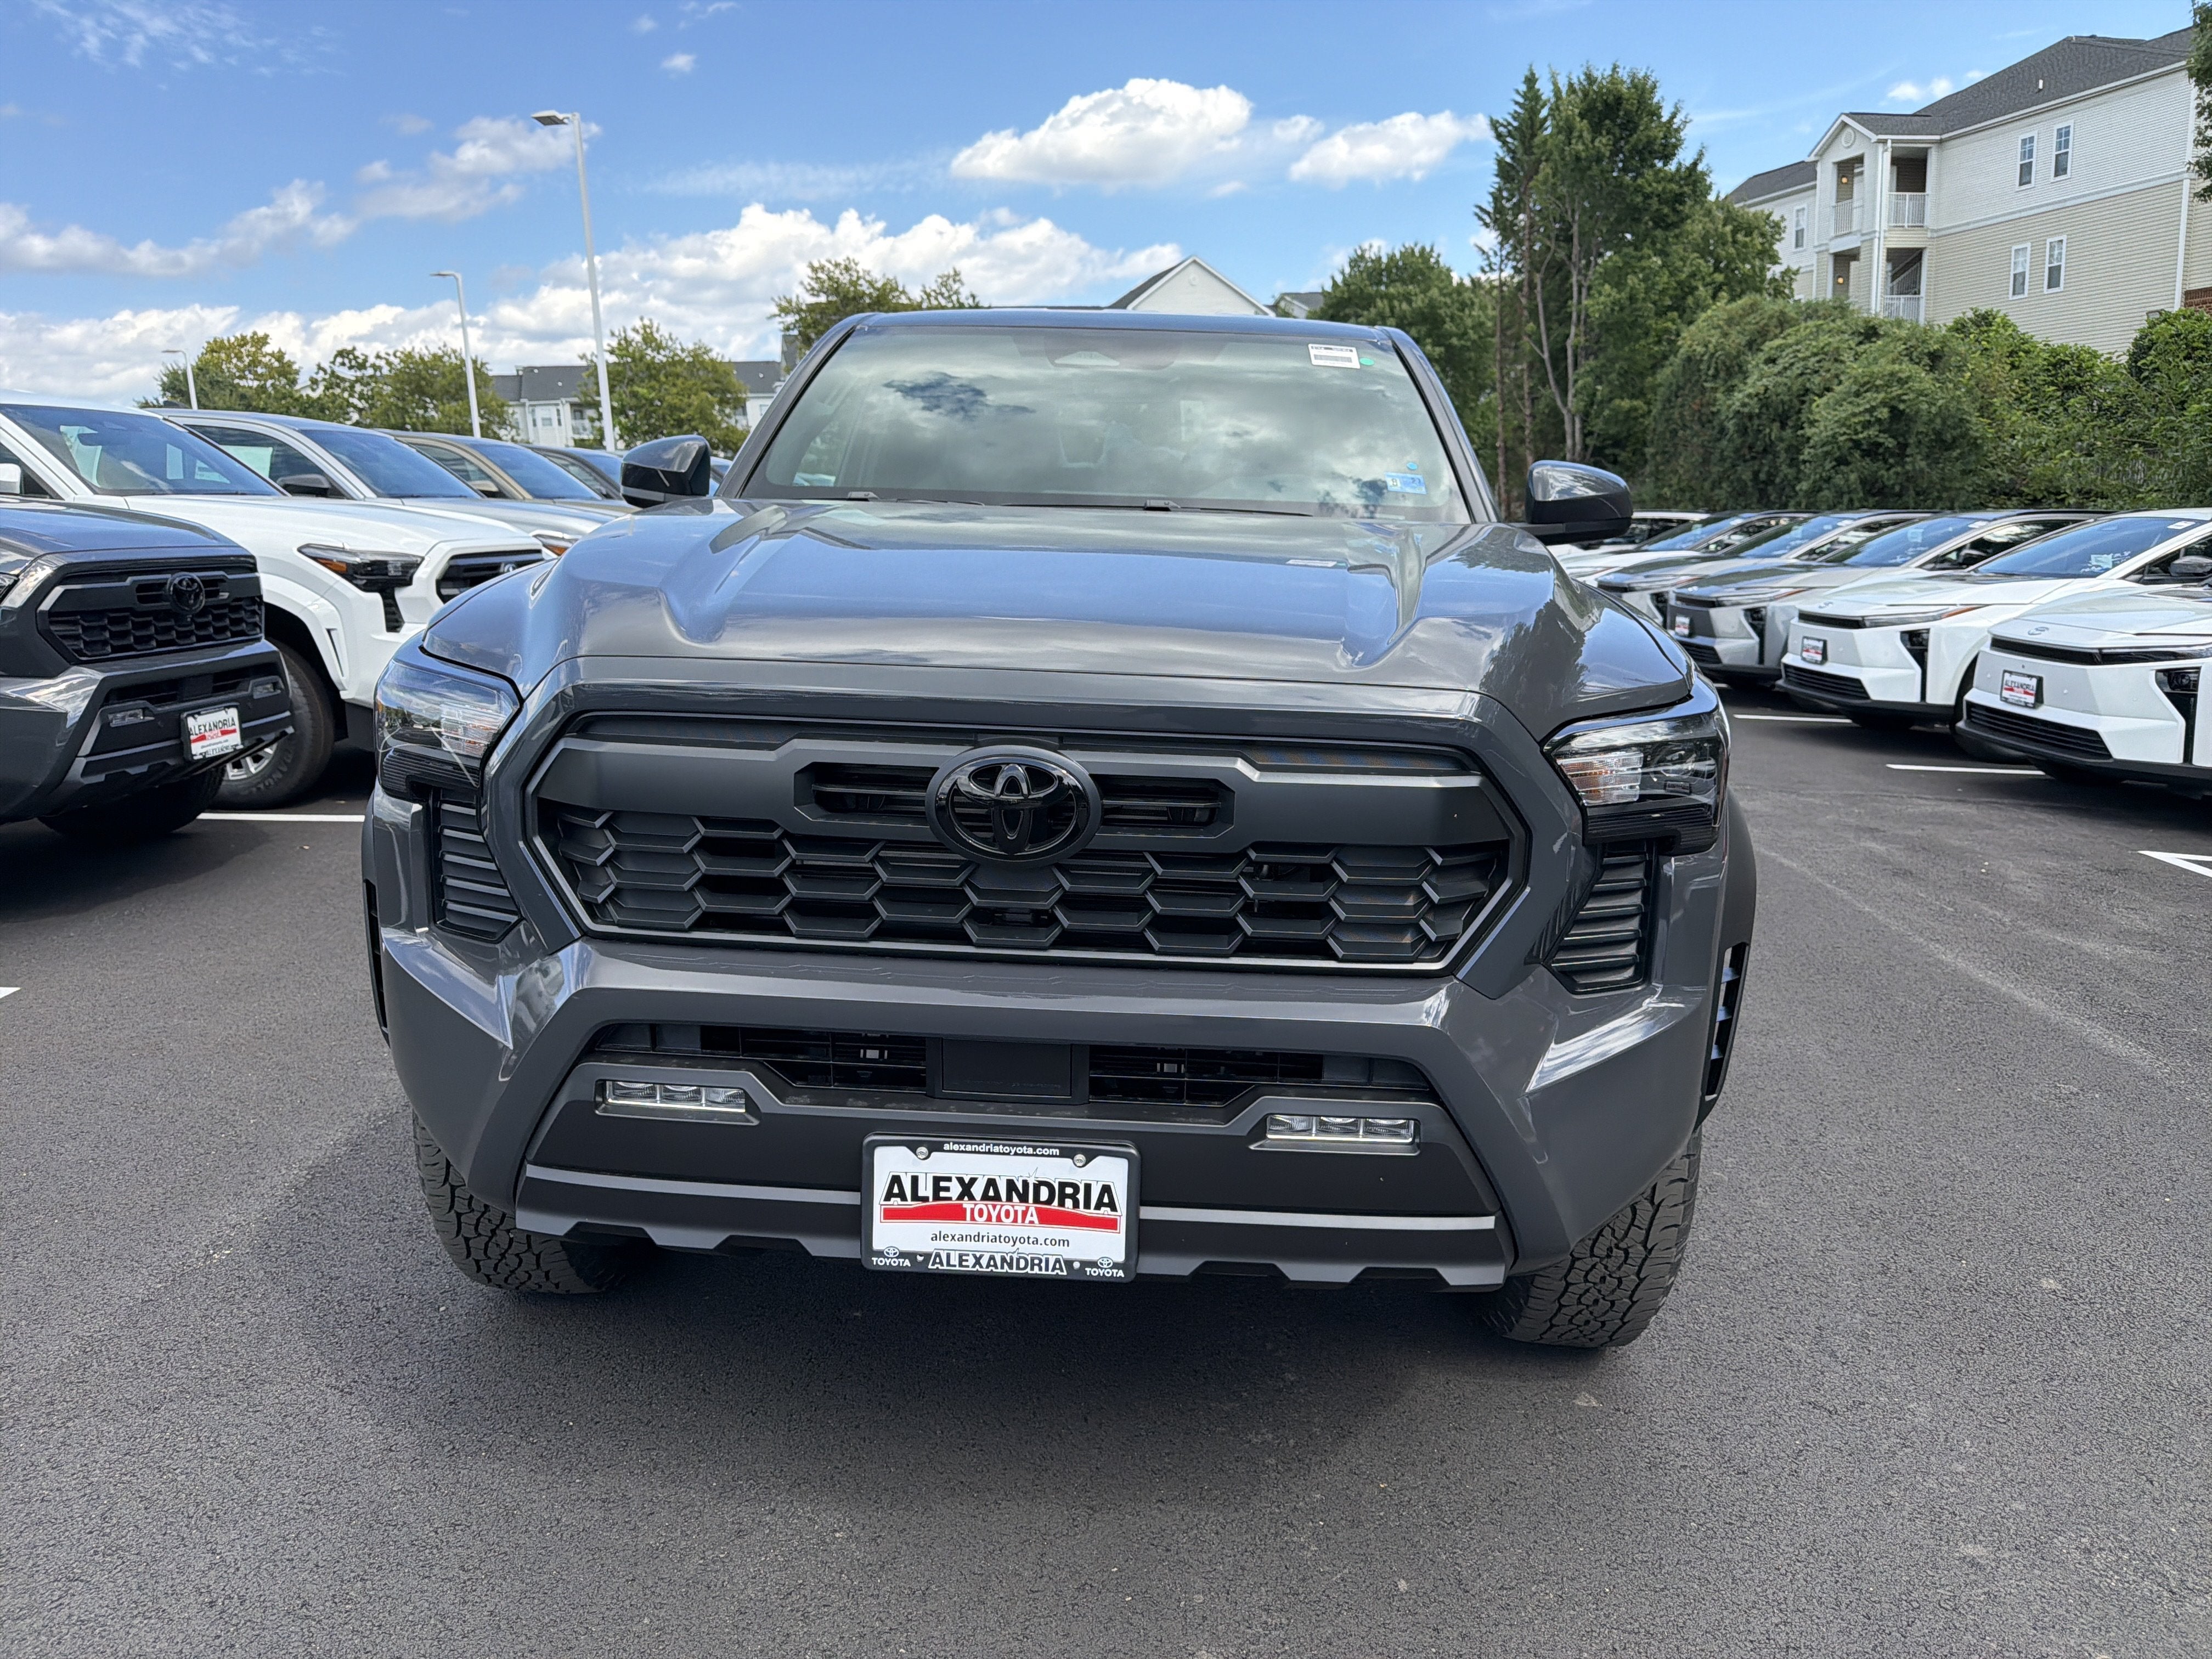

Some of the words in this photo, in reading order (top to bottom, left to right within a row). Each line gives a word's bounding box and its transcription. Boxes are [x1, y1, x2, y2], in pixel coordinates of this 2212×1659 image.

[189, 716, 236, 736] ALEXANDRIA
[944, 1142, 1059, 1156] alexandriatoyota.com
[882, 1173, 1119, 1213] ALEXANDRIA
[963, 1203, 1040, 1224] TOYOTA
[930, 1231, 1070, 1247] alexandriatoyota.com
[872, 1257, 911, 1267] TOYOTA
[929, 1250, 1066, 1274] ALEXANDRIA
[1085, 1268, 1125, 1277] TOYOTA
